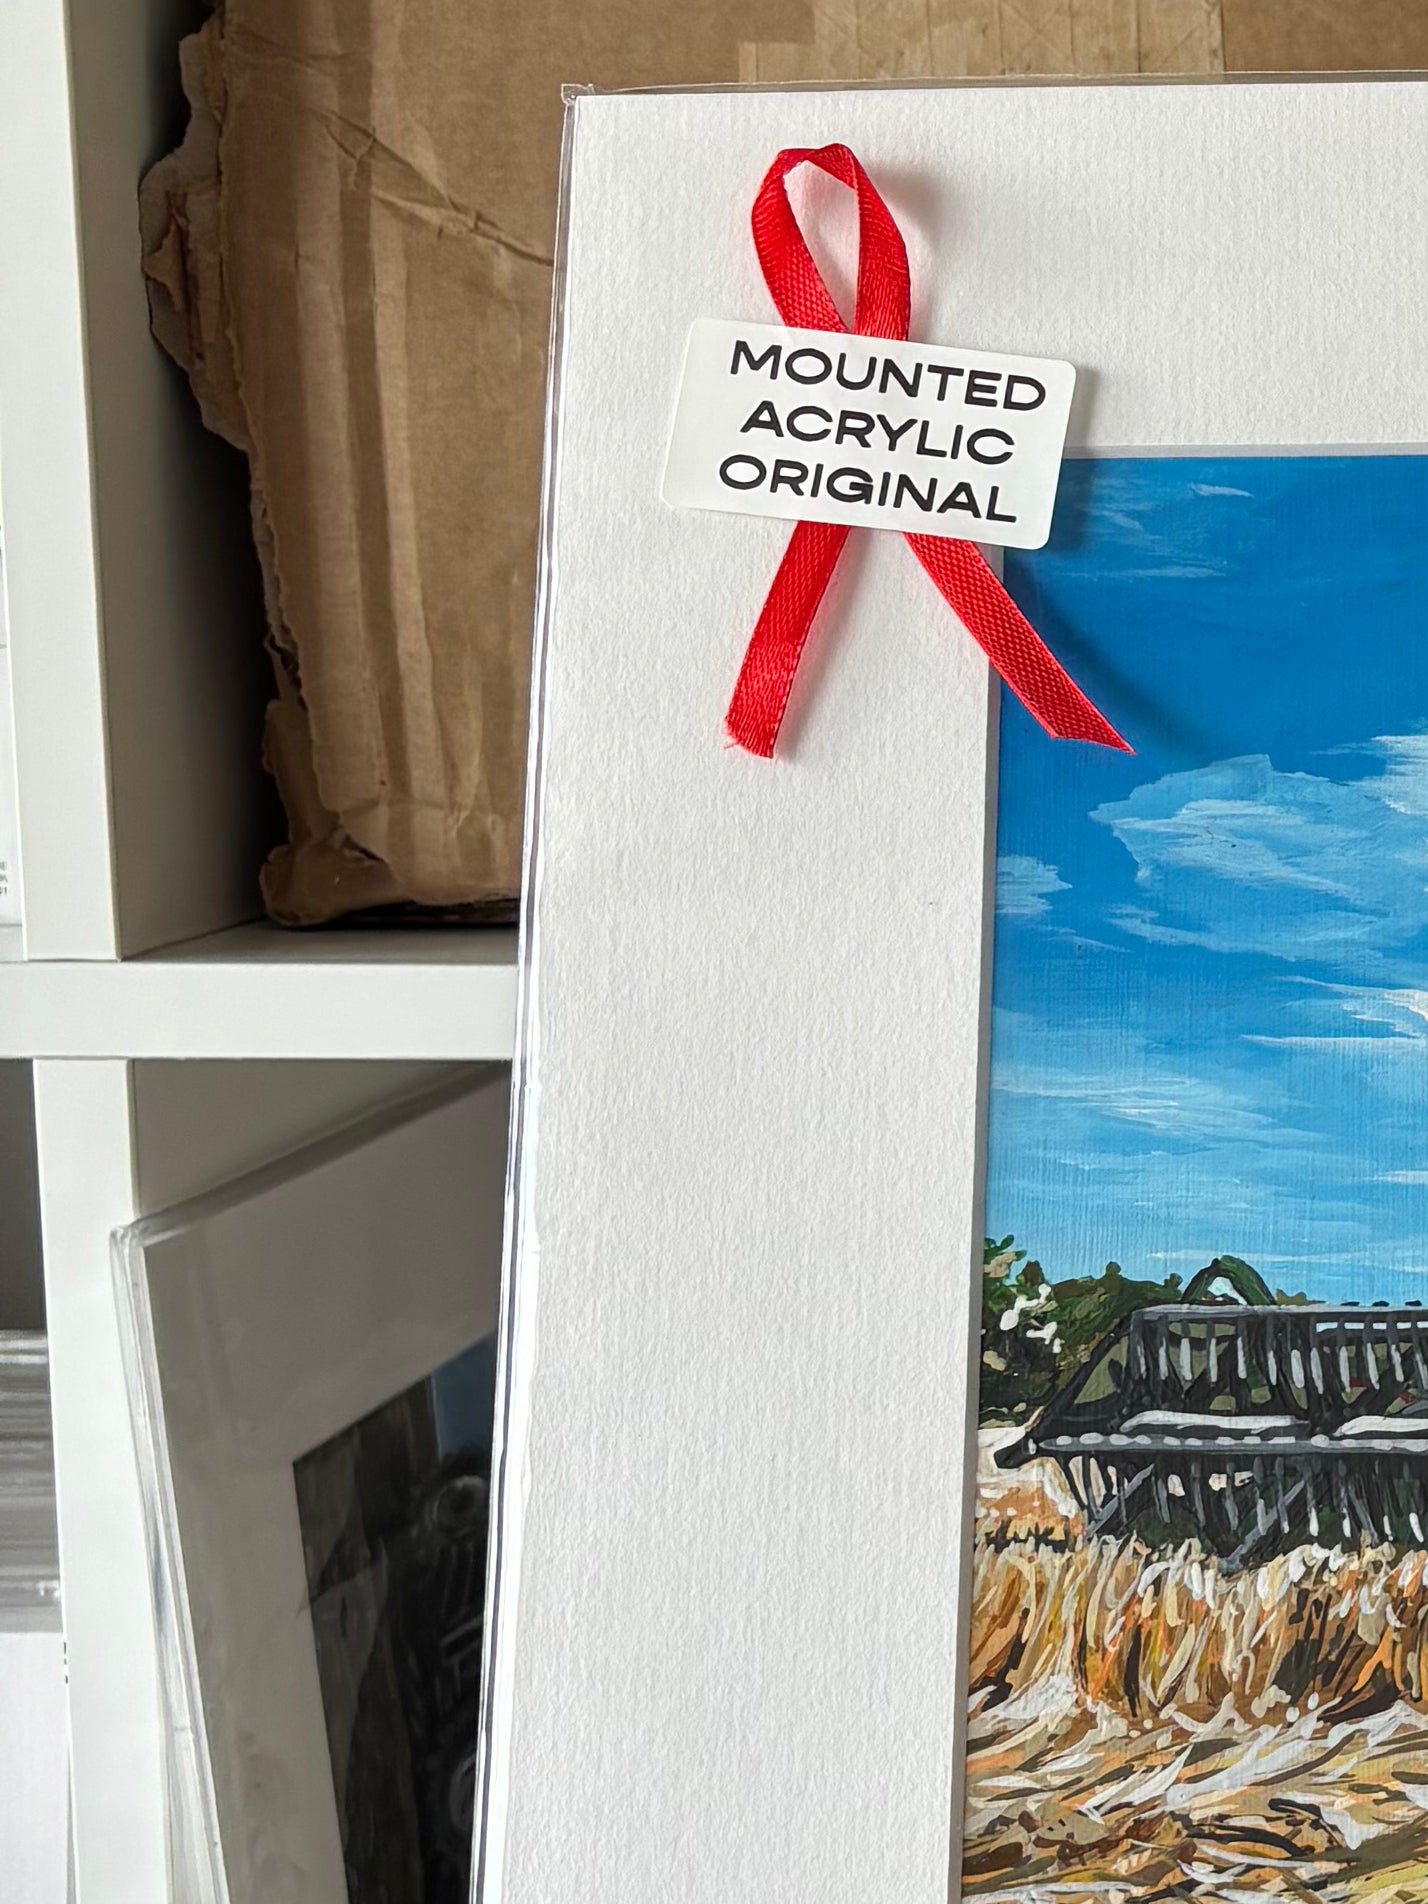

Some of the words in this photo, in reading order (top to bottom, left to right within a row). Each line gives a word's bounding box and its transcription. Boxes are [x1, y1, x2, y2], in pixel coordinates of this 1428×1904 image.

[729, 339, 1047, 412] MOUNTED
[739, 399, 1016, 466] ACRYLIC
[718, 453, 1018, 524] ORIGINAL
